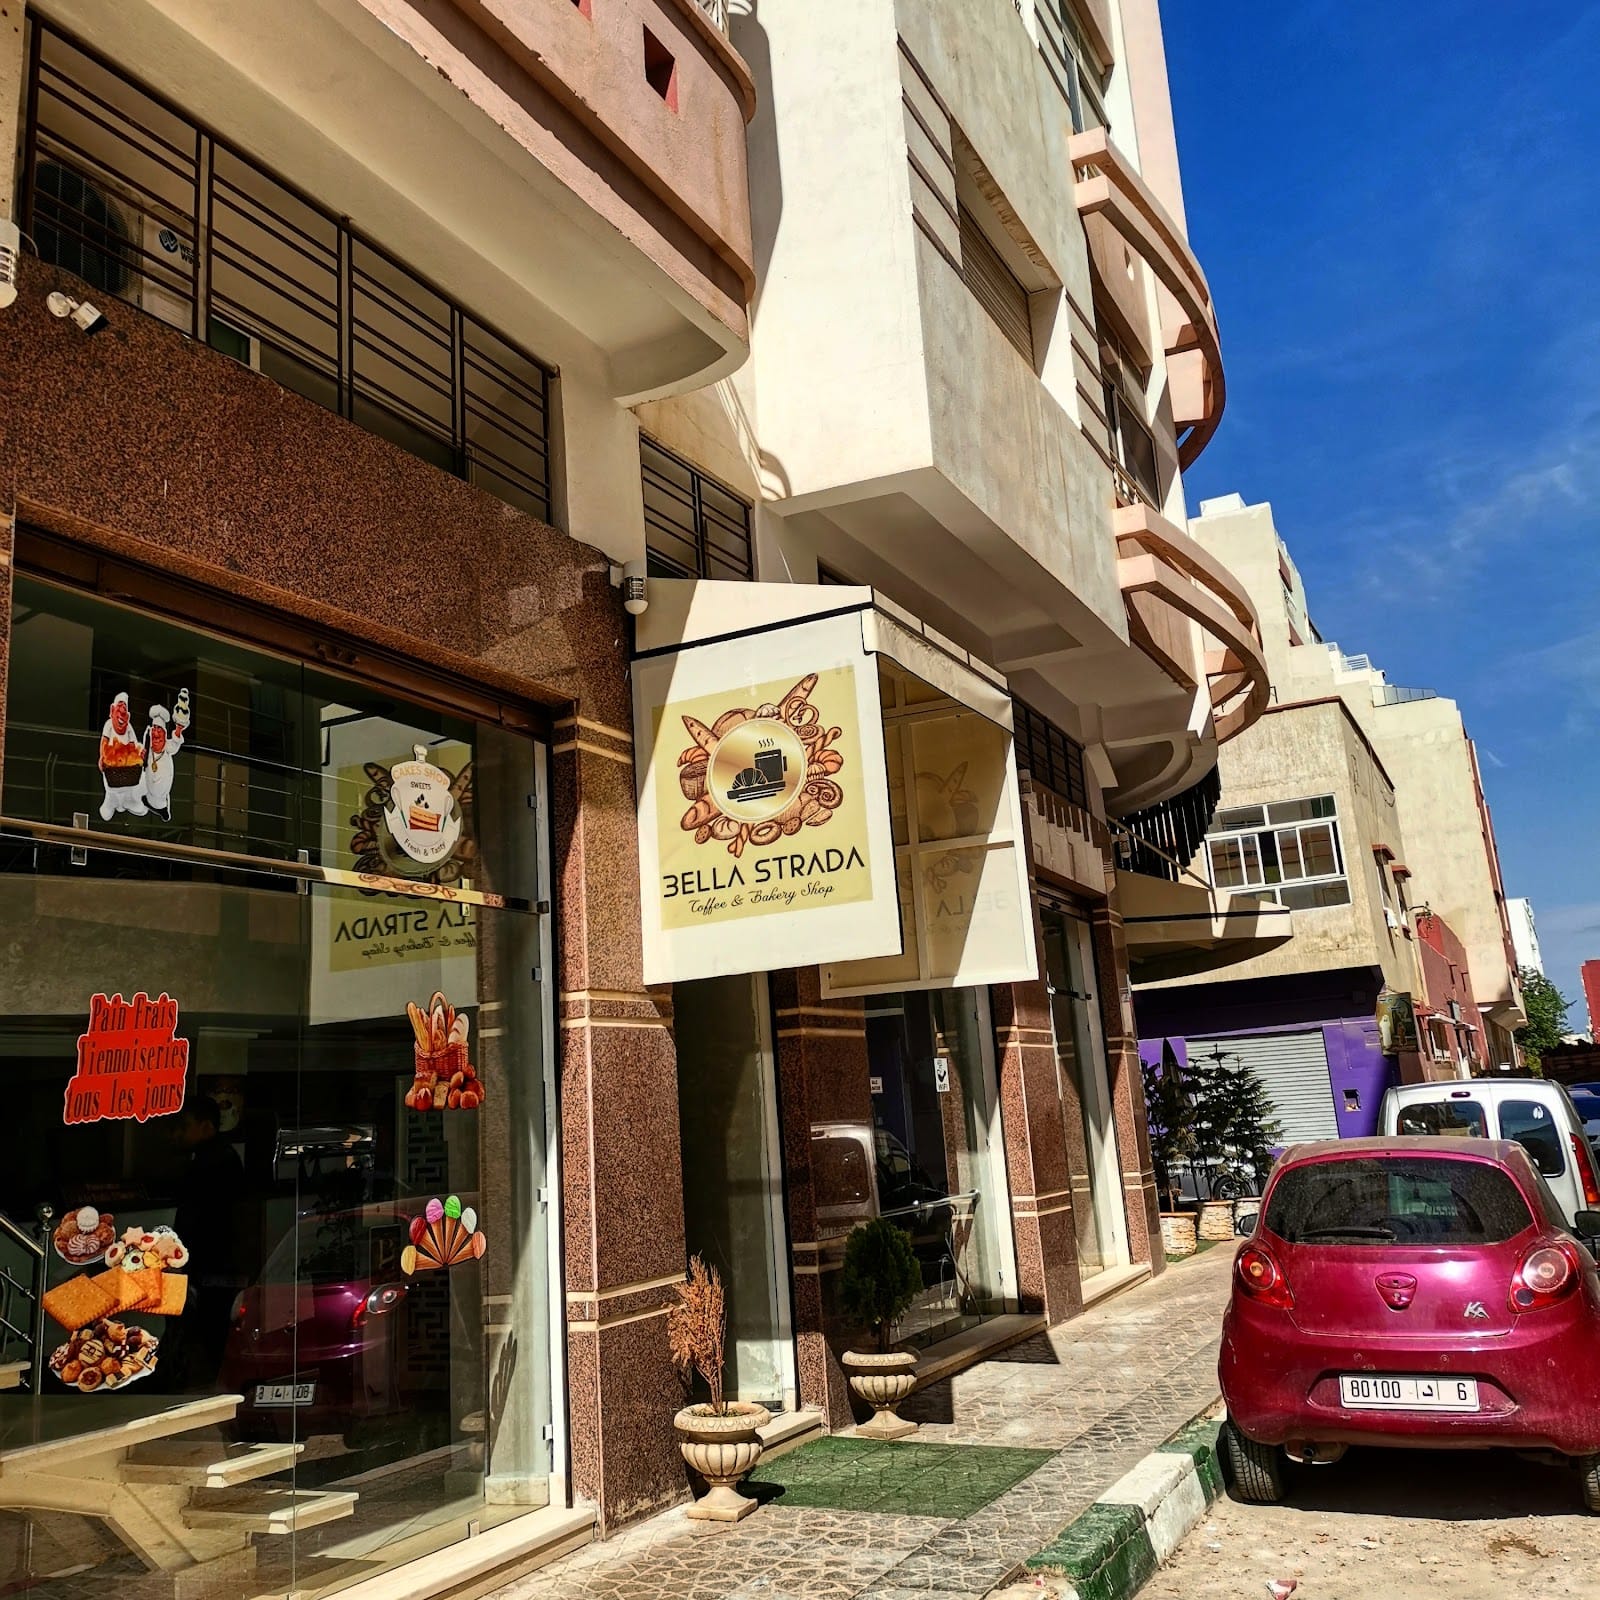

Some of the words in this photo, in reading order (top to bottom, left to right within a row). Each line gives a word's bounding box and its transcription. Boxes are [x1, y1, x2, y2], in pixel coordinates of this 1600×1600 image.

[394, 765, 421, 779] CAKES
[424, 768, 448, 785] SHOP
[410, 781, 432, 790] SWEETS
[403, 838, 421, 855] Fresh
[423, 848, 429, 857] &
[431, 842, 446, 855] Tasty
[663, 864, 745, 898] BELLA
[755, 845, 865, 883] STRADA
[731, 894, 744, 907] &
[748, 887, 798, 906] Bakery
[801, 881, 835, 898] Shop
[92, 998, 126, 1031] Pain
[134, 995, 176, 1029] Frais
[79, 1038, 187, 1075] Viennoiseries
[65, 1086, 101, 1119] tous
[110, 1078, 135, 1114] les
[141, 1078, 183, 1114] jours
[1350, 1380, 1401, 1398] 80100
[1457, 1382, 1467, 1401] 6
